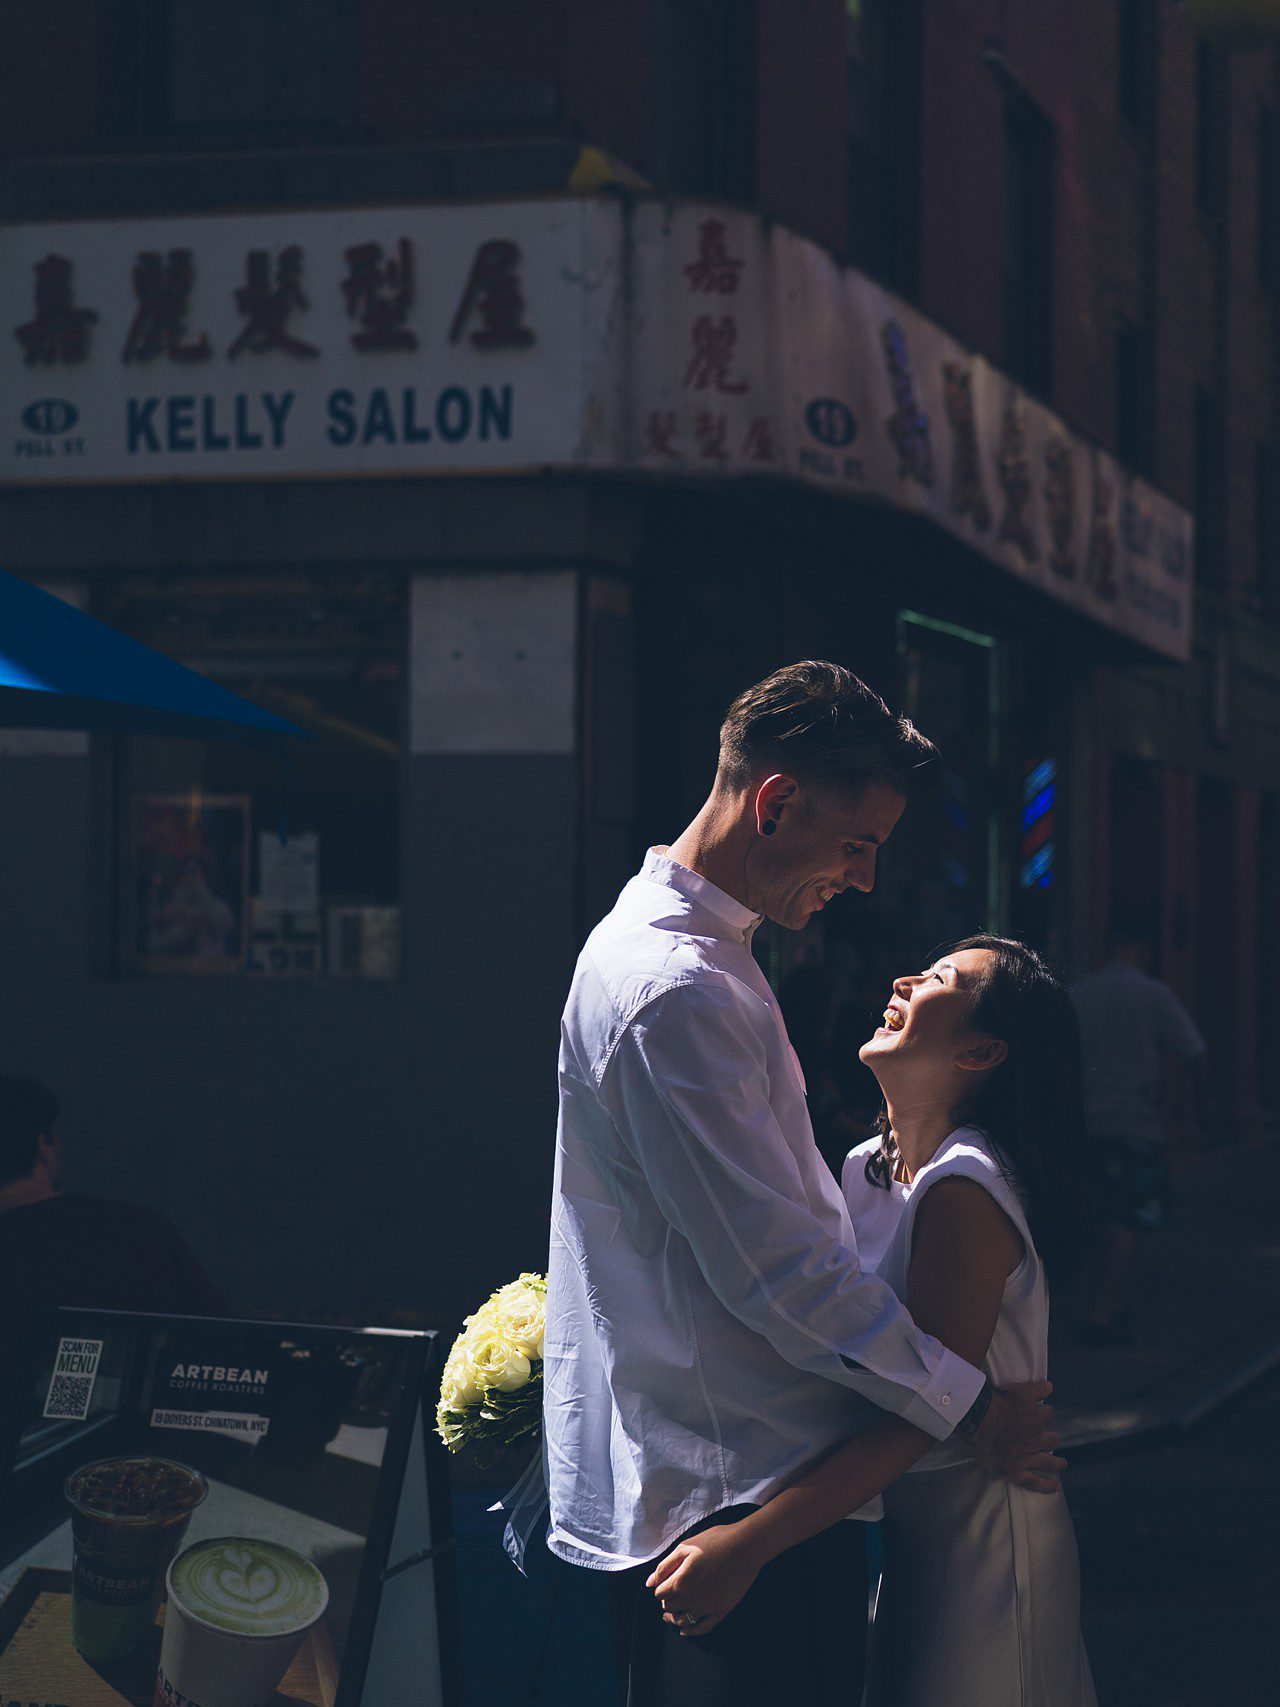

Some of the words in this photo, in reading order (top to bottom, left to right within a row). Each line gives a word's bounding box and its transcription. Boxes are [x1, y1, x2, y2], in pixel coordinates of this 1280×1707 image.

[127, 392, 296, 455] KELLY
[327, 384, 514, 447] SALON
[61, 1340, 84, 1353] SCAN
[84, 1343, 100, 1354] FOR
[57, 1353, 97, 1374] MENU
[171, 1363, 270, 1385] ARTBEAN
[169, 1379, 209, 1391] COFFEE
[212, 1382, 266, 1396] ROASTERS
[155, 1412, 164, 1424] 19
[164, 1413, 193, 1427] DOYERS
[251, 1418, 266, 1432] NYC
